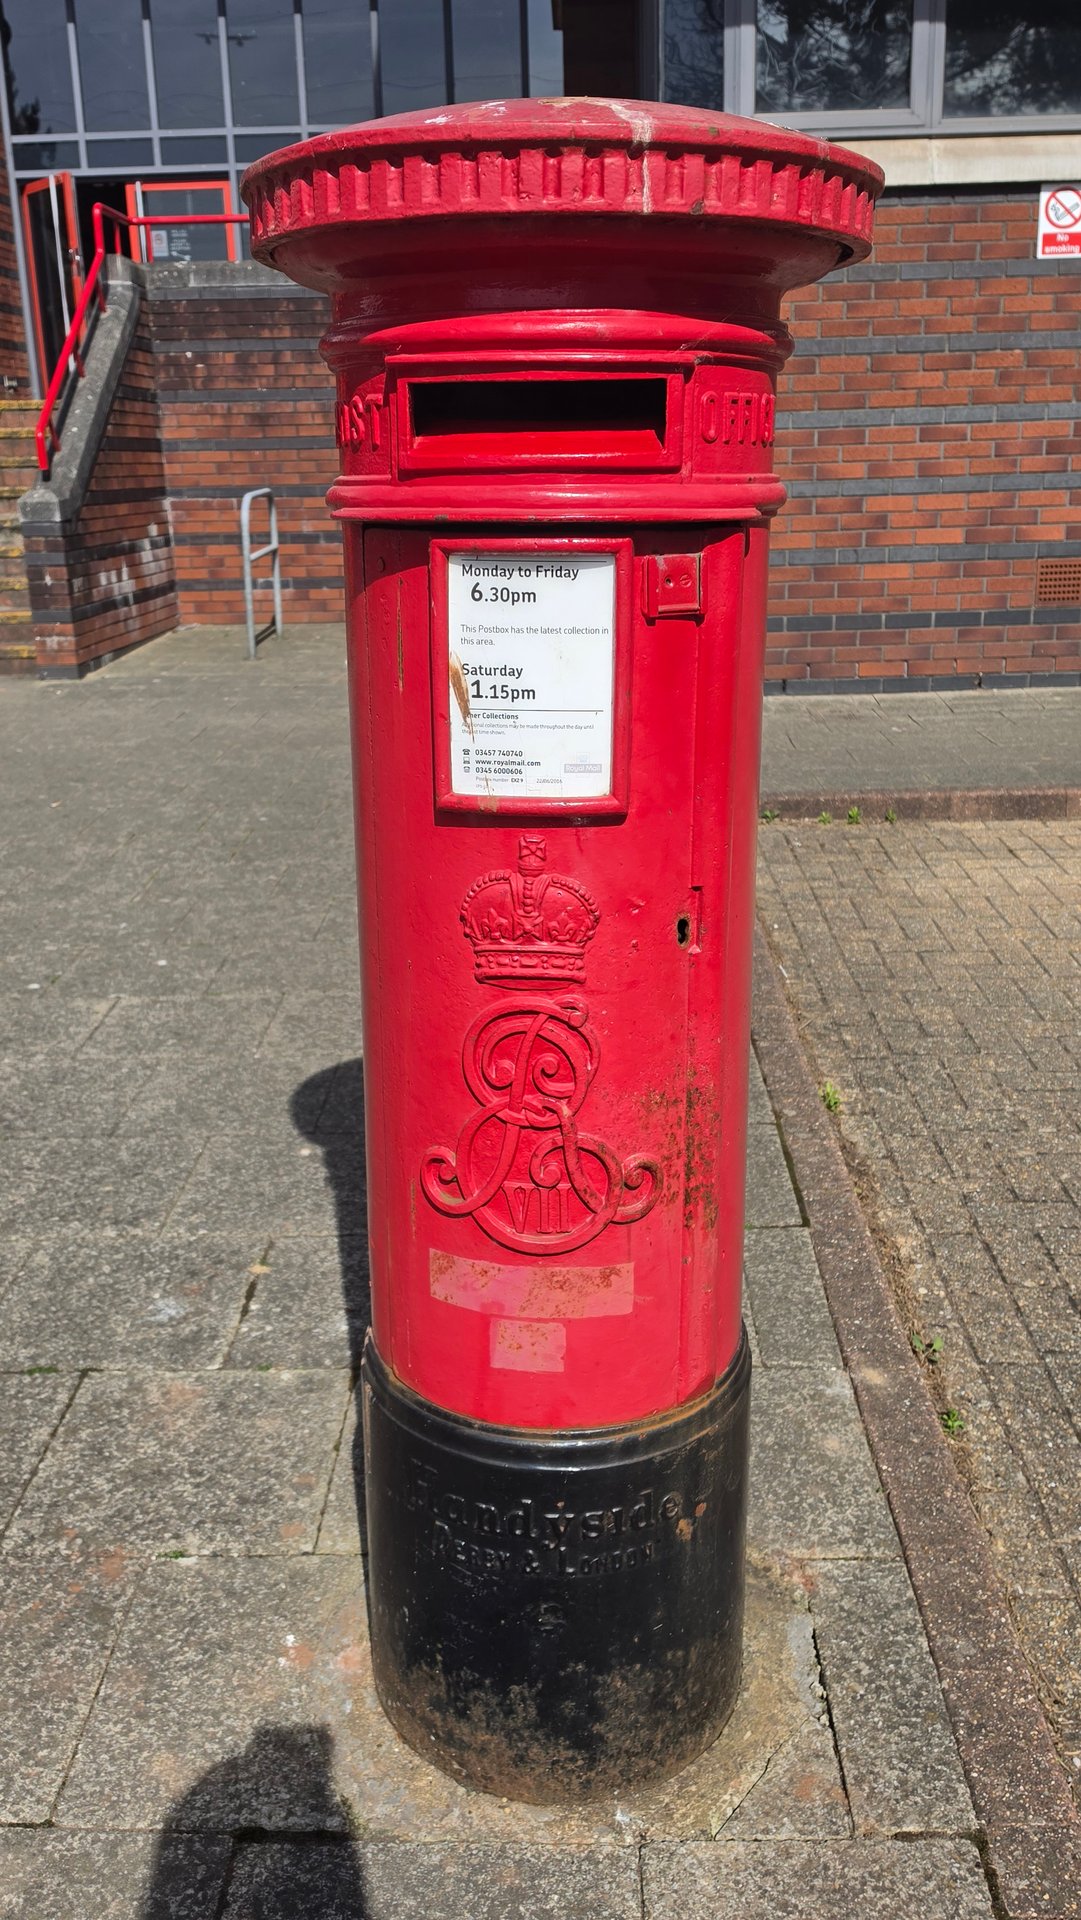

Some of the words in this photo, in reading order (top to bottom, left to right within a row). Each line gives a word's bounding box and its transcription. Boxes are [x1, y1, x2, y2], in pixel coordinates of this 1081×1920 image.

[1056, 233, 1069, 242] No
[1044, 244, 1080, 254] smoking
[461, 564, 515, 580] Monday
[518, 566, 532, 578] to
[535, 565, 580, 581] Friday
[470, 581, 537, 606] 6.30pm
[460, 624, 477, 633] This
[478, 624, 510, 634] Postbox
[510, 625, 525, 634] has
[526, 625, 539, 634] the
[540, 626, 562, 635] latest
[563, 626, 600, 635] collection
[601, 626, 609, 635] in
[460, 637, 475, 645] this
[475, 638, 496, 646] area.
[462, 663, 524, 679] Saturday
[470, 679, 536, 702] 1.15pm
[482, 712, 519, 720] Collections
[498, 749, 524, 757] 740740
[475, 759, 541, 767] www.royalmail.com
[494, 767, 523, 775] 6000606
[521, 1548, 543, 1575] &
